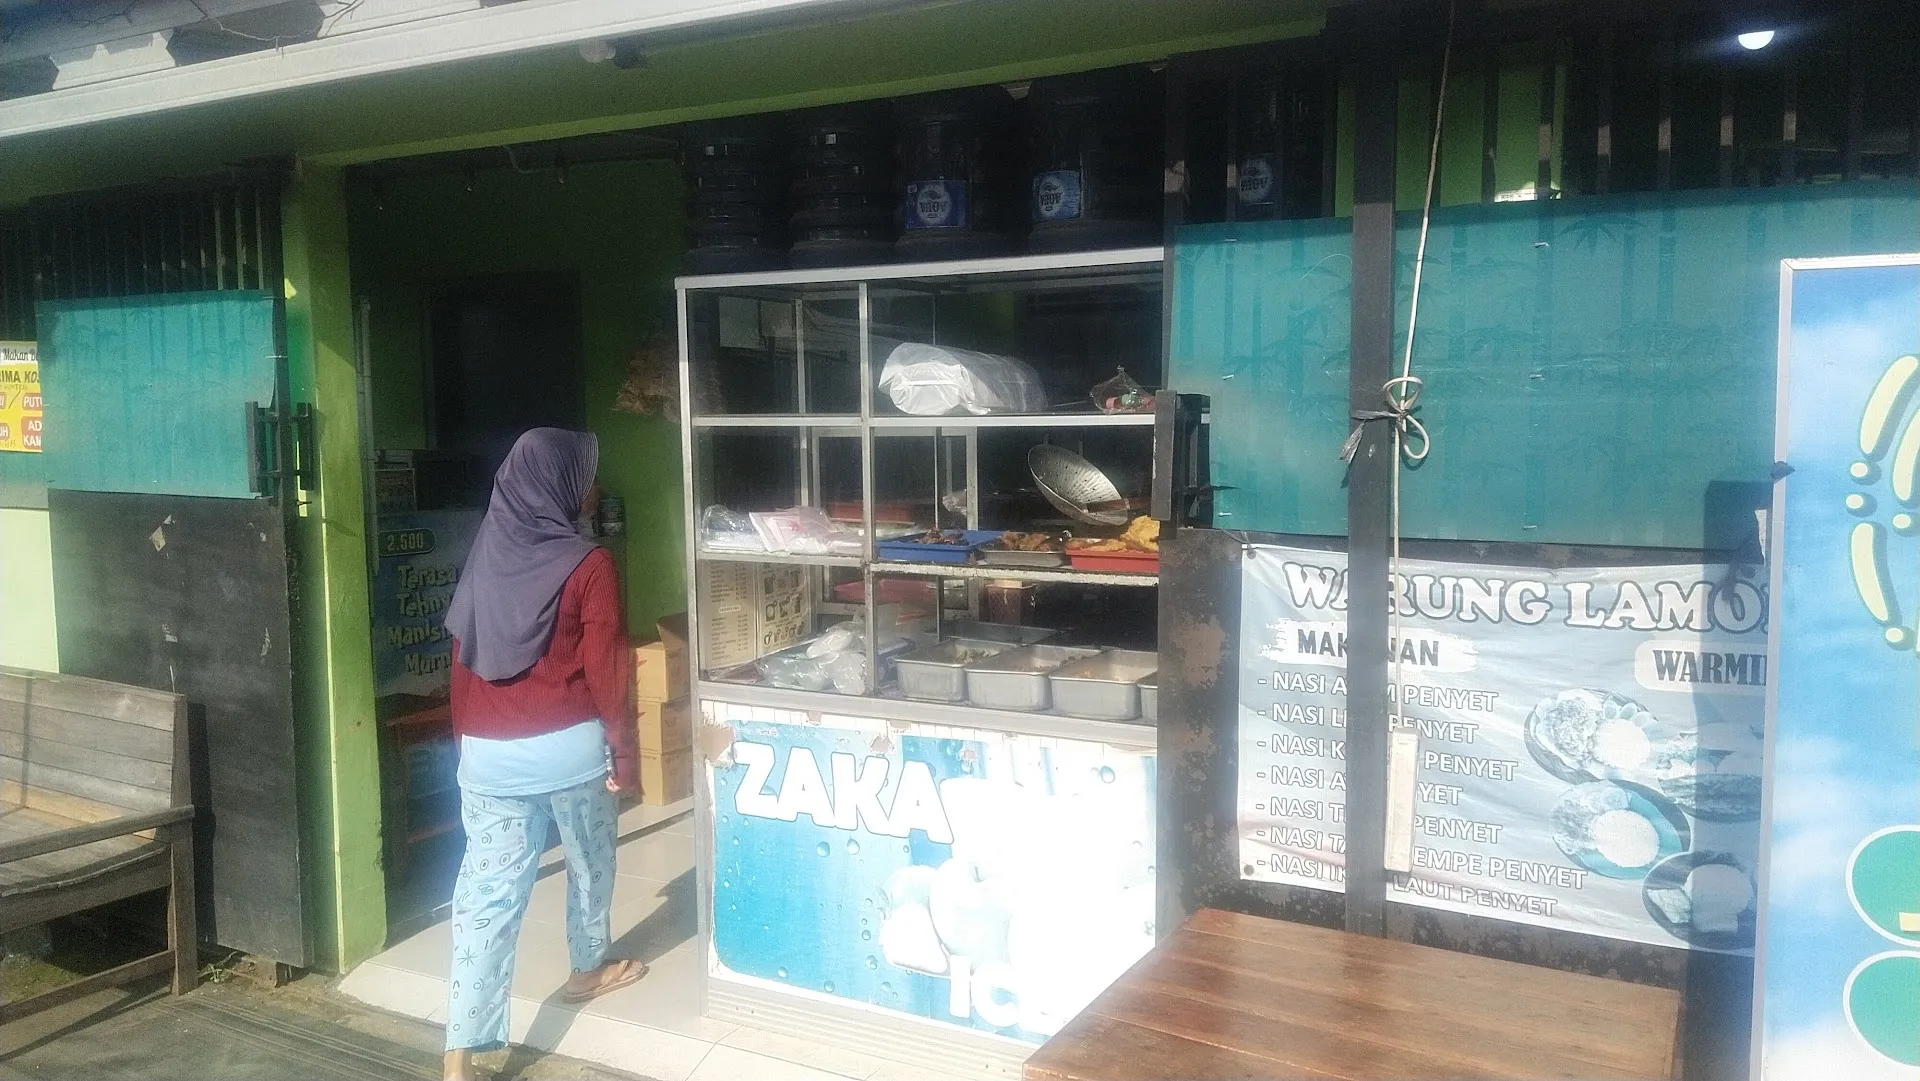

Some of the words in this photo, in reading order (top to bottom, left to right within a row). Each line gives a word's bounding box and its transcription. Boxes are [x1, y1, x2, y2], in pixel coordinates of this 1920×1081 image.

[0, 370, 21, 383] IMA
[387, 533, 424, 551] 2.500
[1563, 580, 1768, 634] LAMO
[1653, 650, 1767, 685] WARMI
[1272, 671, 1325, 694] NASI
[1404, 684, 1499, 712] PENYET
[1272, 703, 1324, 726] NASI
[1271, 734, 1324, 757] NASI
[1424, 750, 1518, 781] PENYET
[1271, 765, 1323, 789] NASI
[1270, 797, 1323, 820] NASI
[1270, 826, 1323, 851] NASI
[1412, 845, 1483, 875] EMPE
[1488, 857, 1588, 890] PENYET
[1270, 853, 1323, 879] NASI
[1391, 873, 1455, 901] LAUT
[1460, 887, 1558, 918] PENYET
